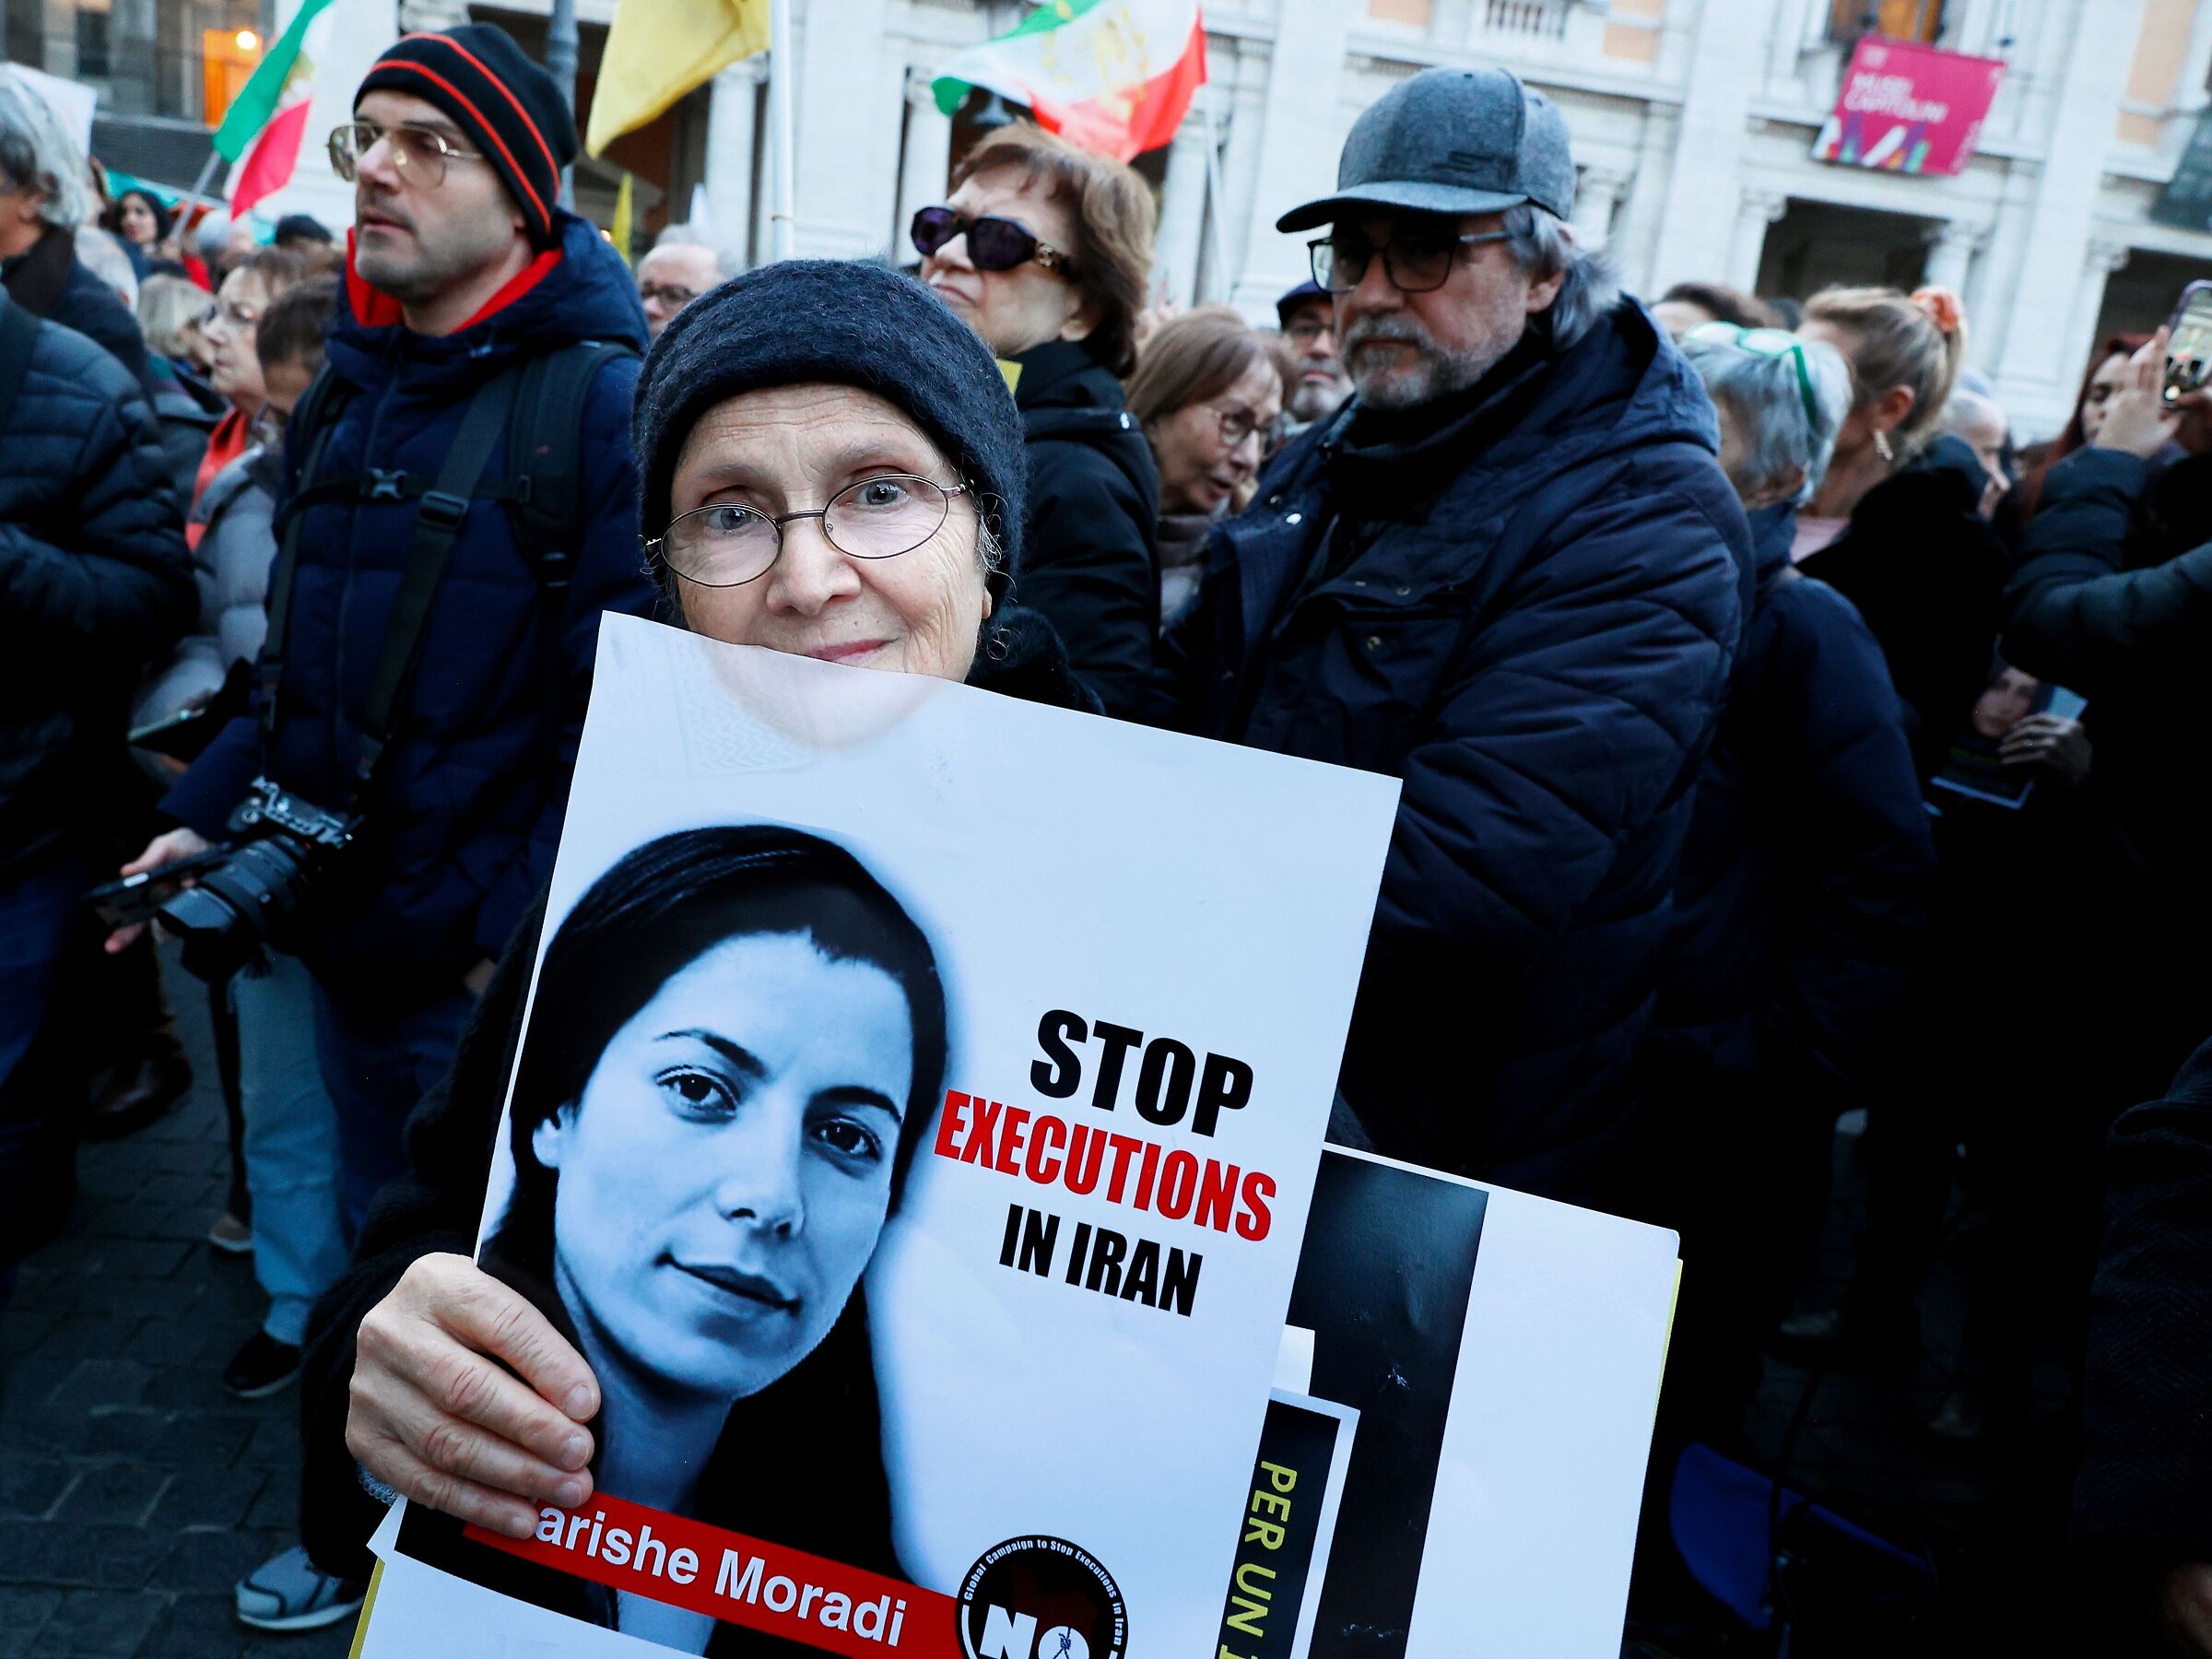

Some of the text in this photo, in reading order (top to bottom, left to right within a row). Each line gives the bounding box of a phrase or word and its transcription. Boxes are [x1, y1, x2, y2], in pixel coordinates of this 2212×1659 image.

[1030, 1009, 1254, 1138] STOP
[934, 1088, 1277, 1242] EXECUTIONS
[998, 1203, 1204, 1318] IN IRAN
[1244, 1461, 1298, 1550] PER
[535, 1507, 907, 1646] arishe Moradi
[964, 1539, 1124, 1646] Global Campaign to Stop Executions in Iran
[1226, 1563, 1277, 1638] UN
